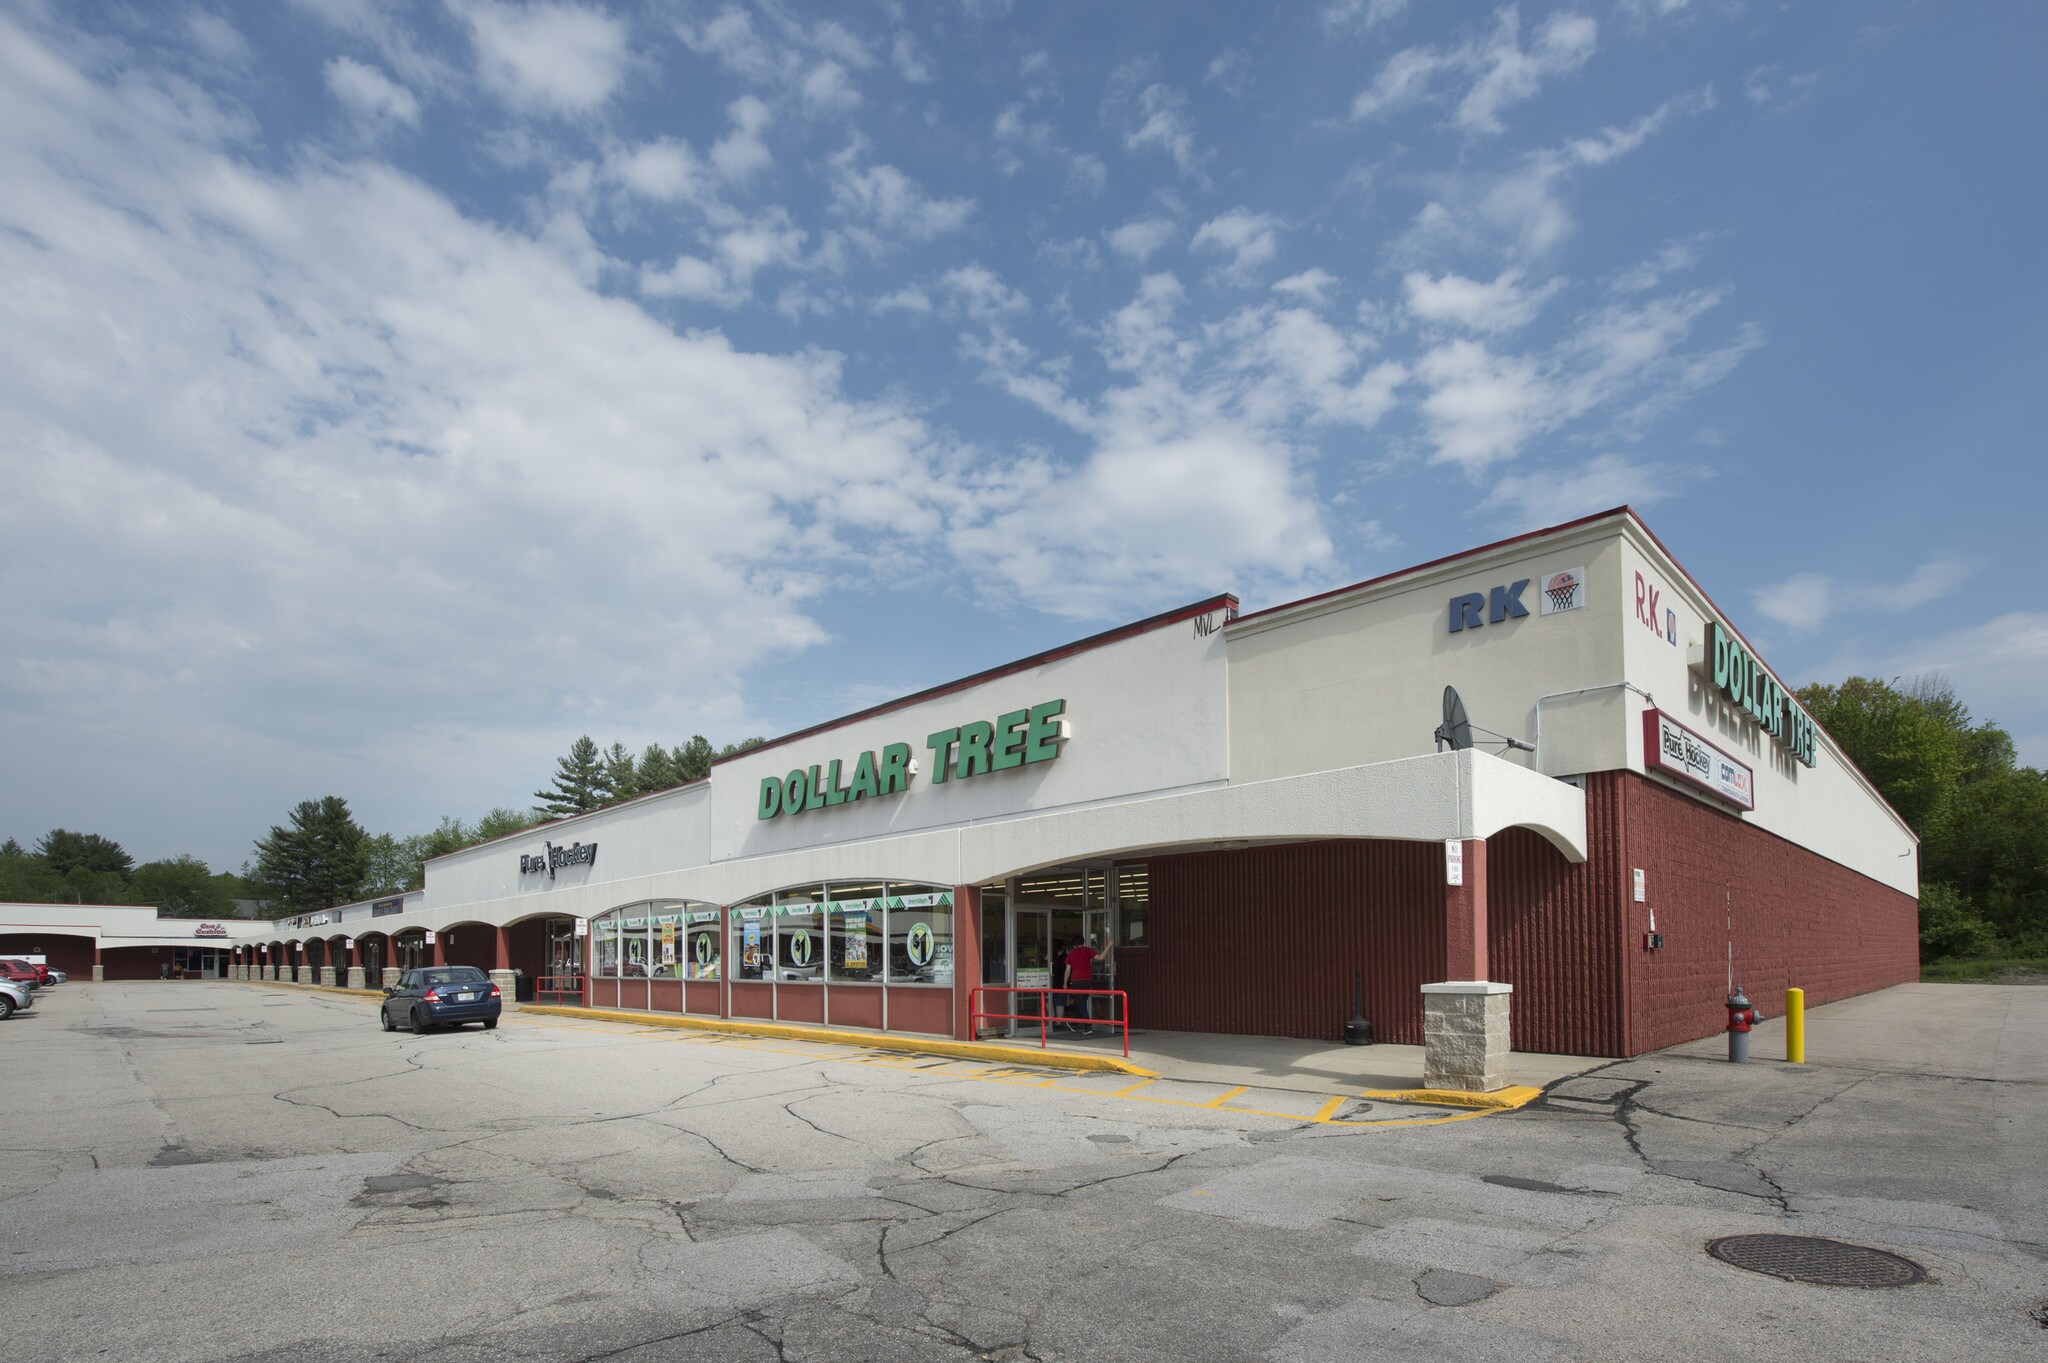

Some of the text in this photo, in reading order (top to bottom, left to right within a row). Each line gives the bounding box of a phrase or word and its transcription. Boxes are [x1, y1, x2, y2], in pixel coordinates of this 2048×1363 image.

[1449, 578, 1531, 634] RK
[1706, 622, 1817, 769] DOLLAR TREE
[757, 699, 1067, 821] DOLLAR TREE
[1662, 726, 1710, 777] Pure Hockey
[520, 842, 598, 873] Pure Hockey
